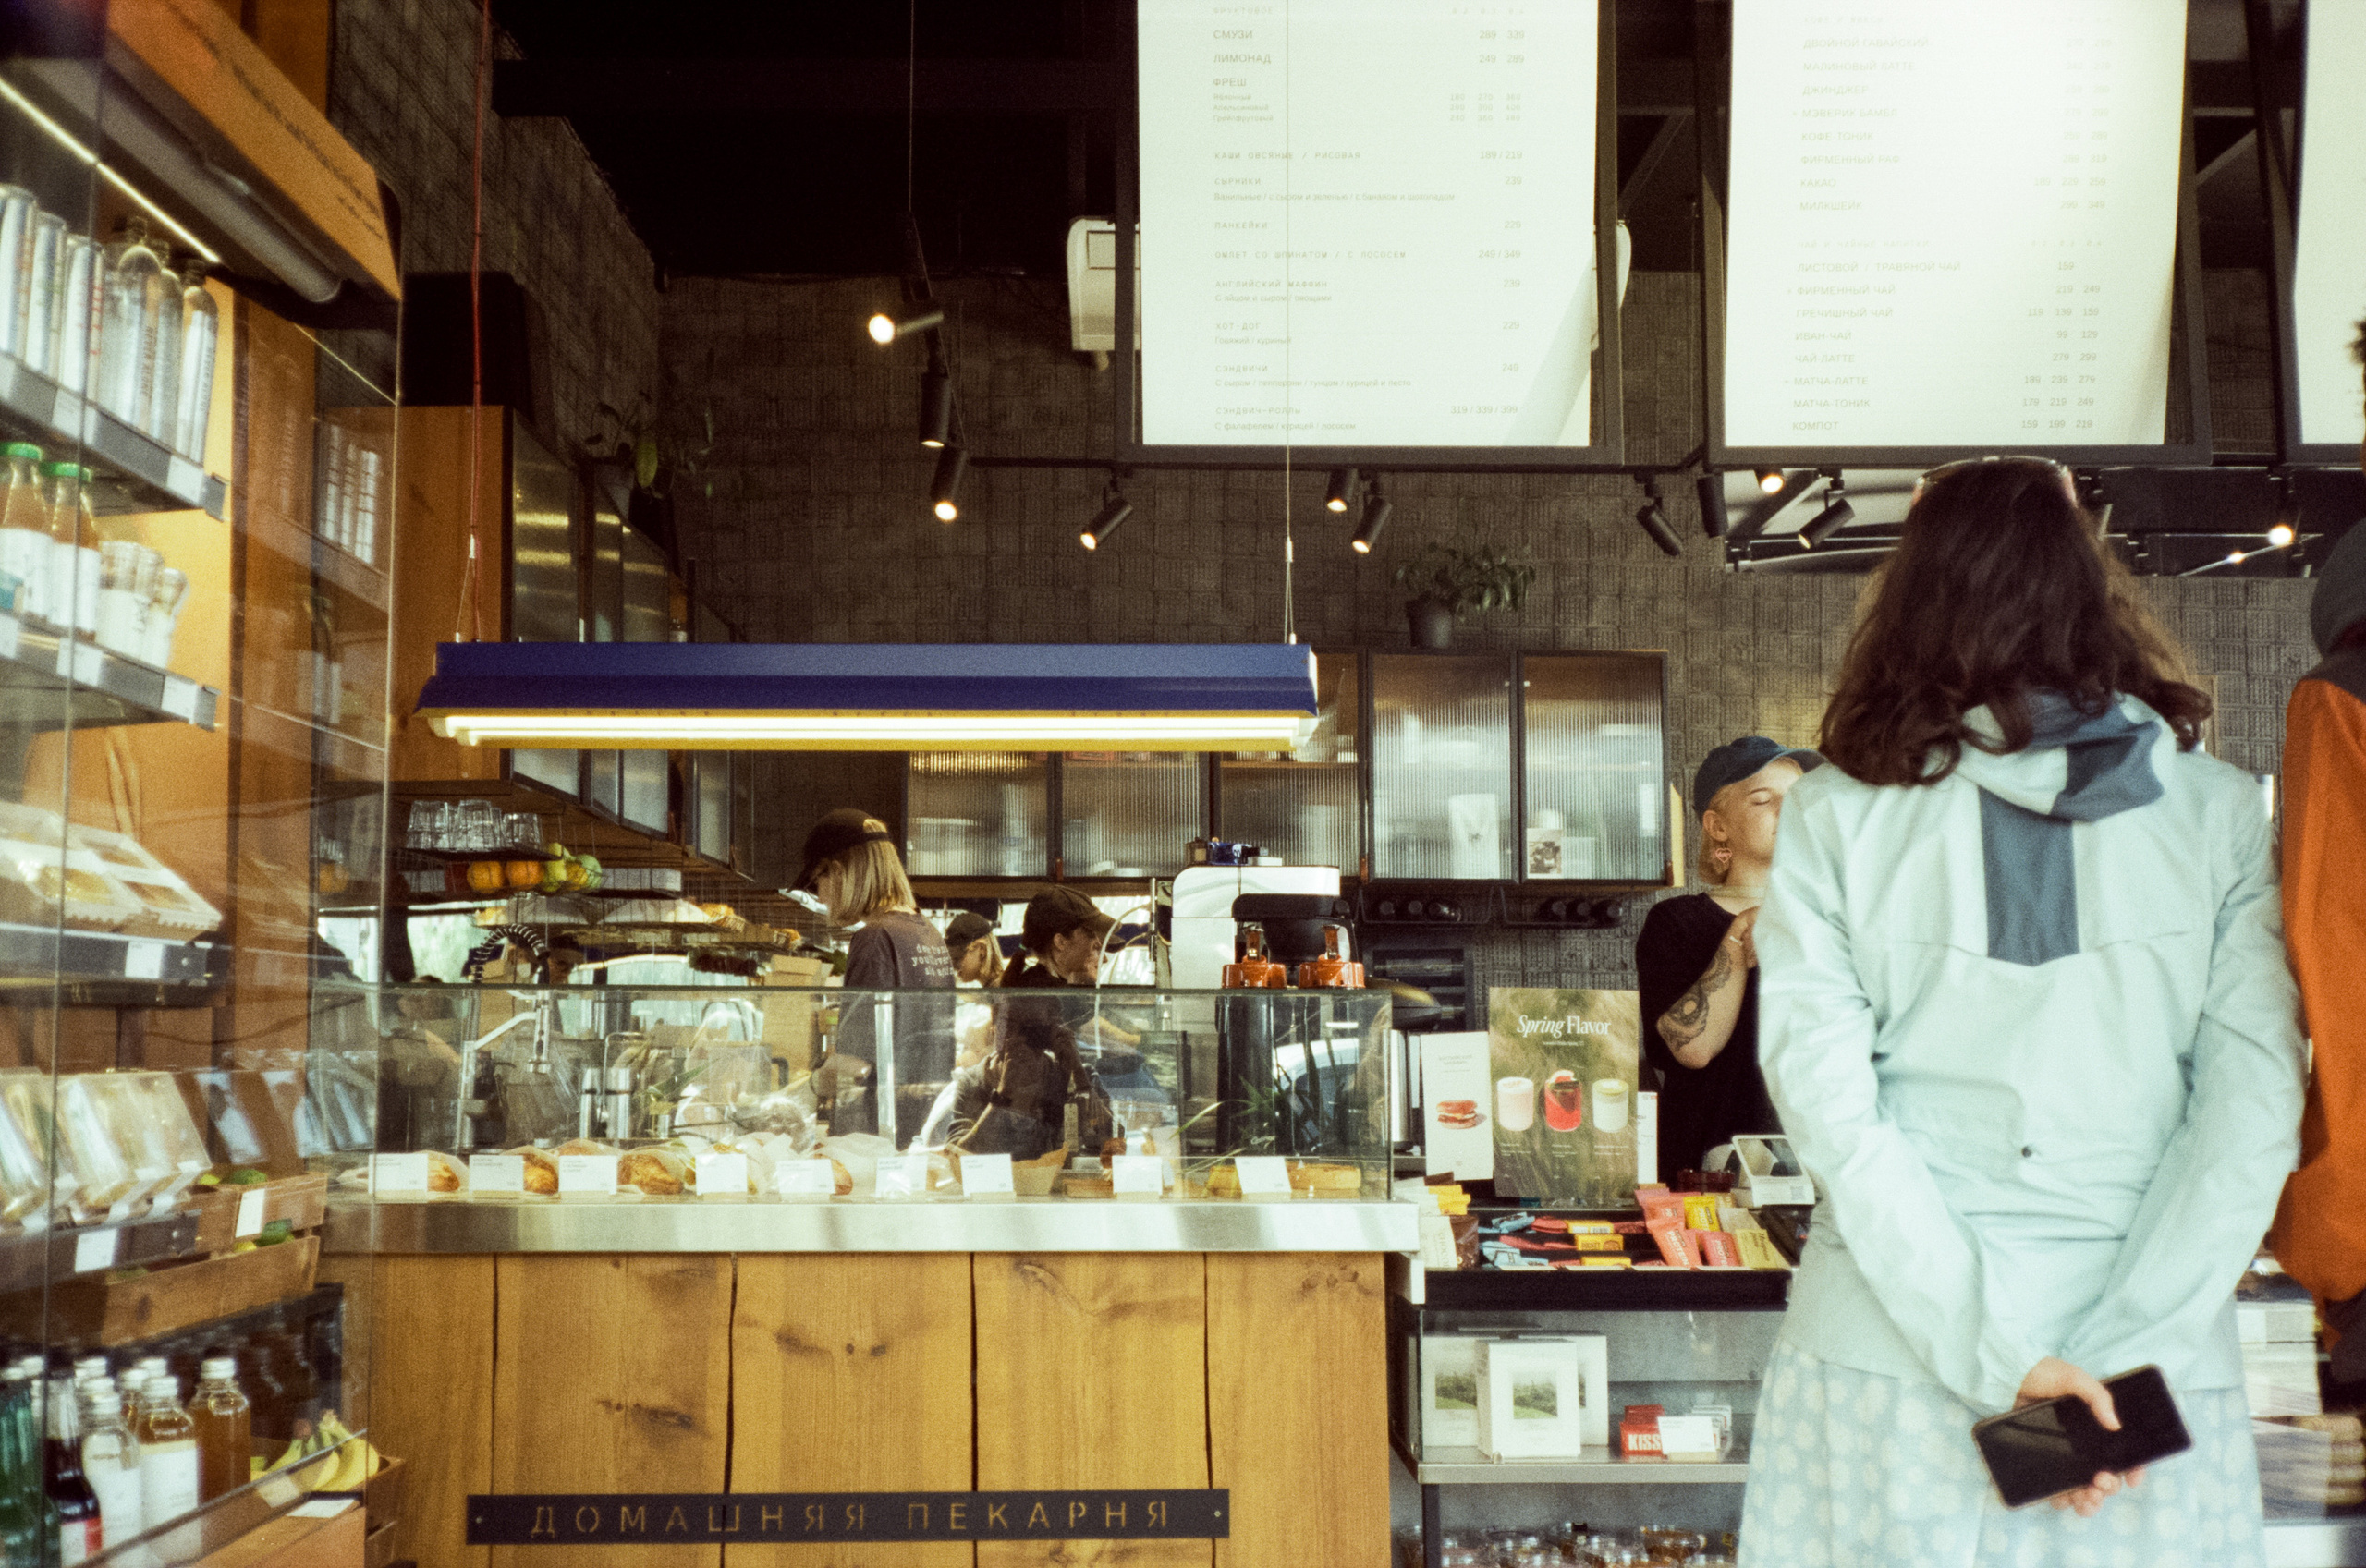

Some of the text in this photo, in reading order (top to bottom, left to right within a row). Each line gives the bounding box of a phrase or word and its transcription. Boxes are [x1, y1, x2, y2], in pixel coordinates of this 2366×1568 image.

[1213, 30, 1252, 39] СМУЗИ
[1480, 30, 1496, 39] 289
[1803, 38, 1859, 48] ДВОЙНОЙ
[1863, 38, 1928, 47] ГАВАЙСКИЙ
[1213, 55, 1524, 64] ЛИМОНАД 249 289
[1803, 62, 1876, 71] МАЛИНОВЫЙ
[1882, 62, 1913, 71] ЛАТТЕ
[1213, 78, 1246, 87] ФРЕШ
[1802, 86, 1867, 95] ДЖИНДЖЕР
[1802, 109, 1854, 117] МЭВЕРИК
[1860, 109, 1896, 117] БАМБЛ
[1214, 151, 1522, 161] КАШИ ОВСЯНЫЕ РИСОВАЯ 189 219
[1800, 155, 1874, 164] ФИРМЕННЫЙ
[1878, 155, 1899, 164] РАФ
[1214, 176, 1522, 186] СЫРНИКИ 239
[1800, 179, 1835, 188] КАКАО
[1799, 201, 1861, 211] МИЛКШЕЙК
[1214, 221, 1267, 230] ПАНКЕЙКИ
[1215, 250, 1247, 260] ОМЛЕТ
[1255, 250, 1268, 260] СО
[1361, 250, 1406, 260] ЛОСОСЕМ
[1479, 250, 1495, 259] 249
[1505, 249, 1521, 259] 349
[1798, 261, 2075, 272] ЛИСТОВОЙ ТРАВЯНОЙ ЧАЙ 159
[1216, 279, 1520, 288] АНГЛИЙСКИЙ МАФФИН 239
[1797, 285, 2101, 295] ФИРМЕННЫЙ ЧАЙ 219 249
[1797, 309, 1867, 318] ГРЕЧИШНЫЙ
[1872, 308, 1893, 317] ЧАЙ
[1216, 321, 1520, 331] ХОТ-ДОГ 229
[1795, 332, 1851, 340] ИВАН-ЧАЙ
[2056, 330, 2067, 339] 99
[1795, 353, 1854, 362] ЧАЙ-ЛАТТЕ
[2053, 353, 2069, 361] 279
[1215, 363, 1519, 373] СЭНДВИЧИ 249
[1346, 380, 1378, 388] курицей
[1388, 379, 1411, 387] песто
[1794, 377, 1866, 385] МАТЧА-ЛАТТЕ
[2052, 375, 2068, 383] 239
[2079, 375, 2095, 383] 279
[1794, 399, 1870, 407] МАТЧА-ТОНИК
[2050, 397, 2067, 407] 219
[2078, 397, 2094, 406] 249
[1451, 406, 1468, 414] 319
[1477, 406, 1493, 414] 339
[1502, 405, 1518, 414] 399
[1224, 422, 1274, 432] фалафелем
[1322, 422, 1356, 431] лососем
[1792, 421, 1838, 431] КОМПОТ
[1517, 1015, 1611, 1039] Spring Flavor
[1666, 1230, 1690, 1266] PROTEIN
[531, 1501, 1167, 1538] ДОМАШНЯЯ ПЕКАРНЯ
